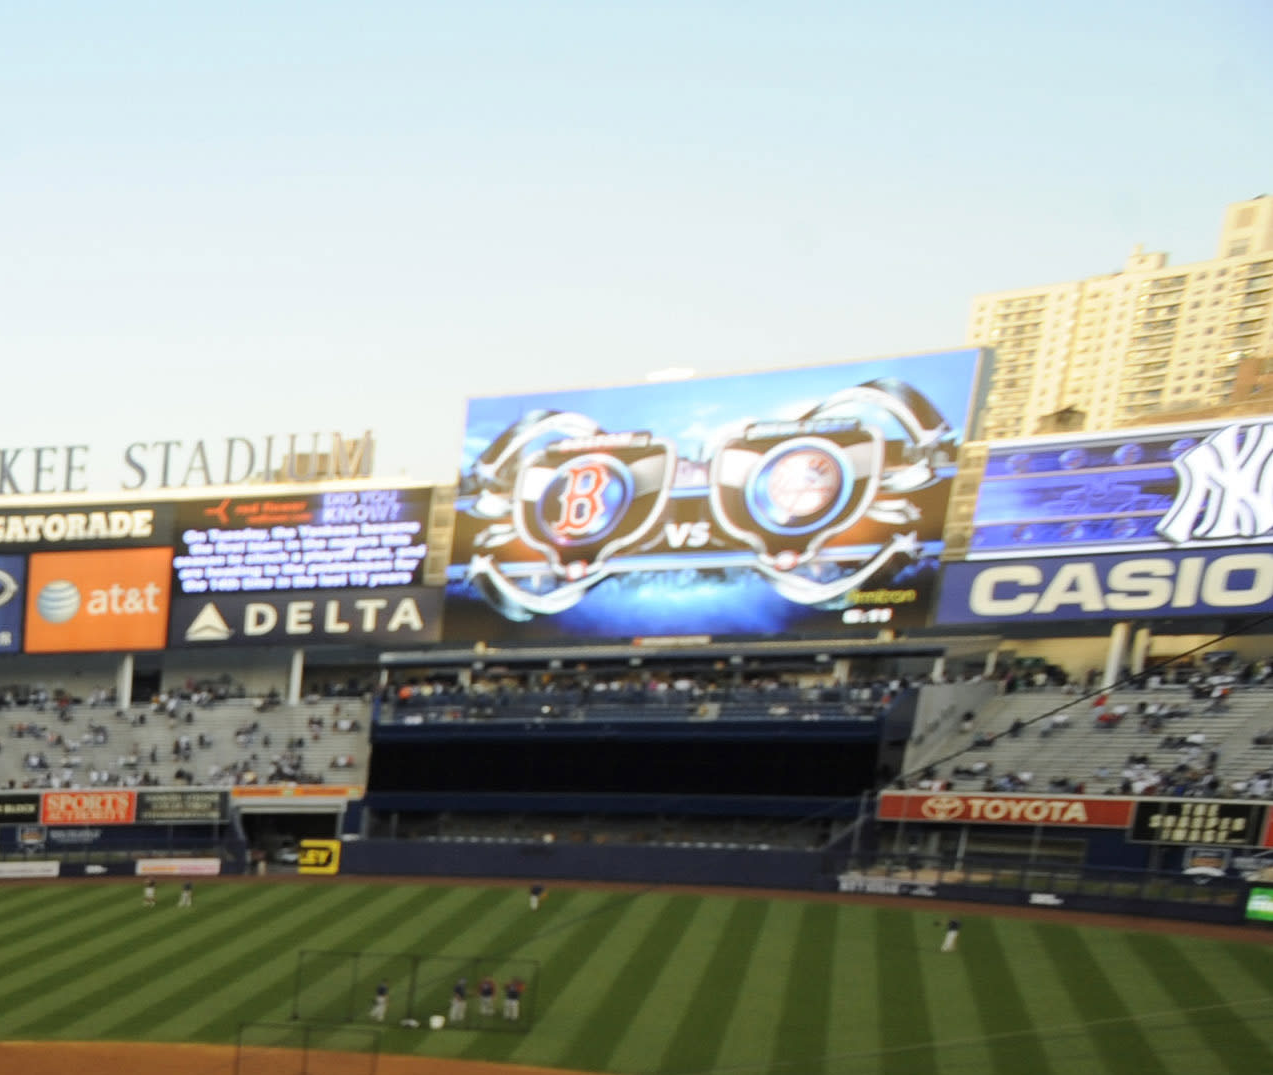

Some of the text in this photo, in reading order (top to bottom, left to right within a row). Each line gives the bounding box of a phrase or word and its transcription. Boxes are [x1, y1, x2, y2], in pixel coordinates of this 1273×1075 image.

[122, 431, 374, 490] STADIUM
[665, 521, 711, 548] VS
[87, 583, 161, 615] at&t
[969, 553, 1273, 617] CASIO
[244, 598, 423, 636] DELTA
[47, 792, 129, 810] SPORTS
[967, 799, 1088, 822] TOYOTA
